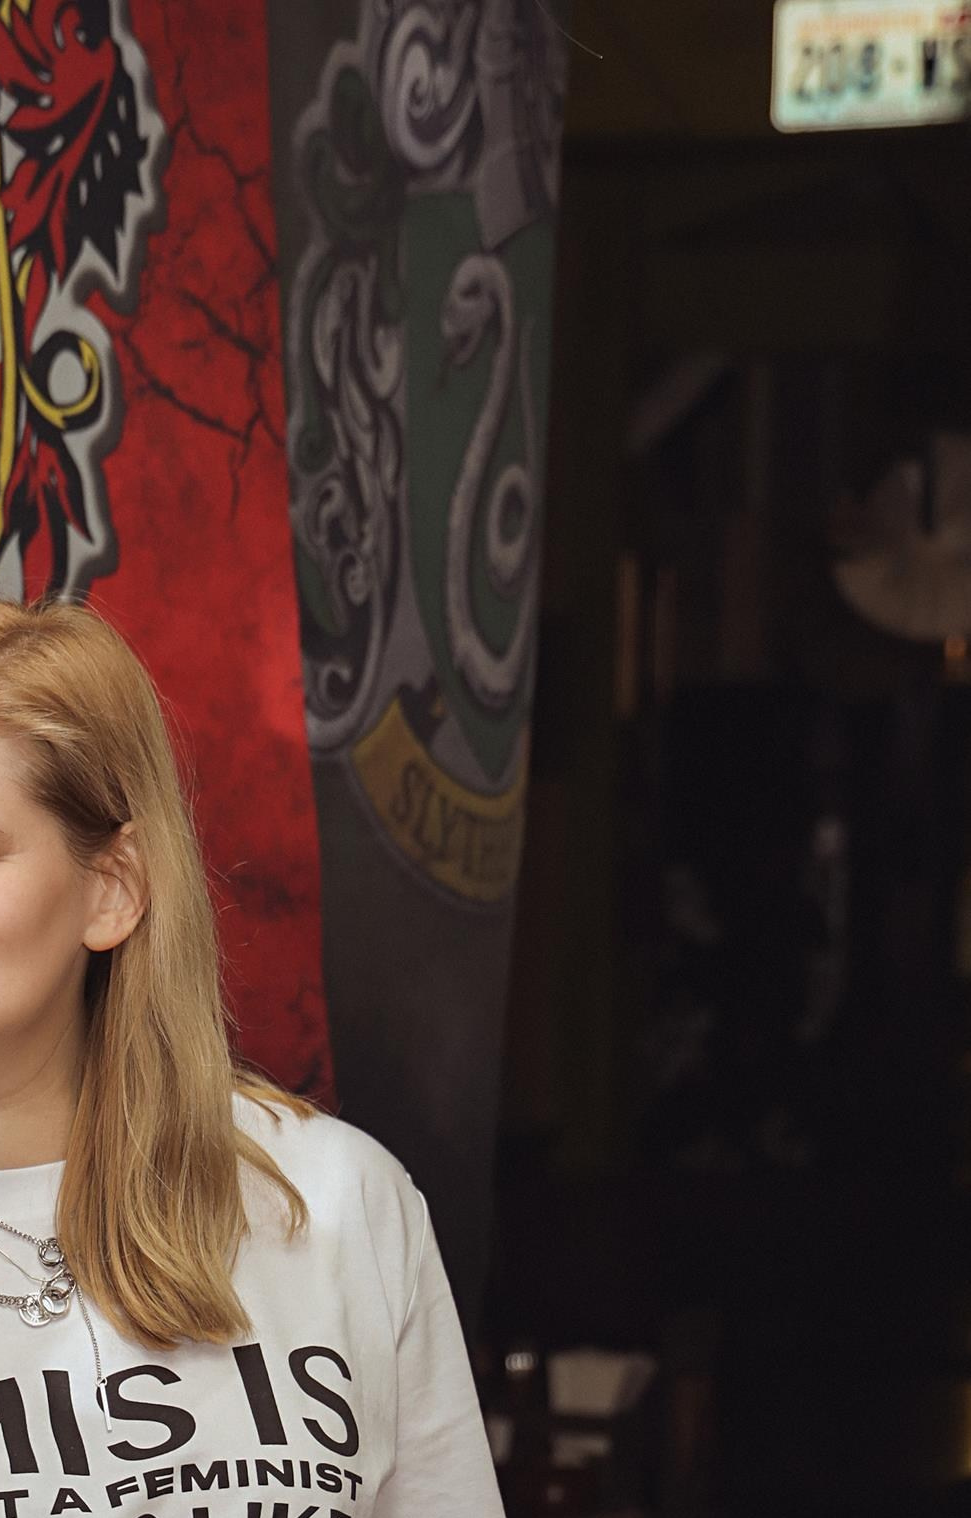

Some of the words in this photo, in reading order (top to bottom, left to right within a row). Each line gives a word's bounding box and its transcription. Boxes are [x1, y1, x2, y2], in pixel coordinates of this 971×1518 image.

[233, 1342, 359, 1457] IS
[50, 1487, 92, 1515] A
[105, 1459, 363, 1508] FEMINIST
